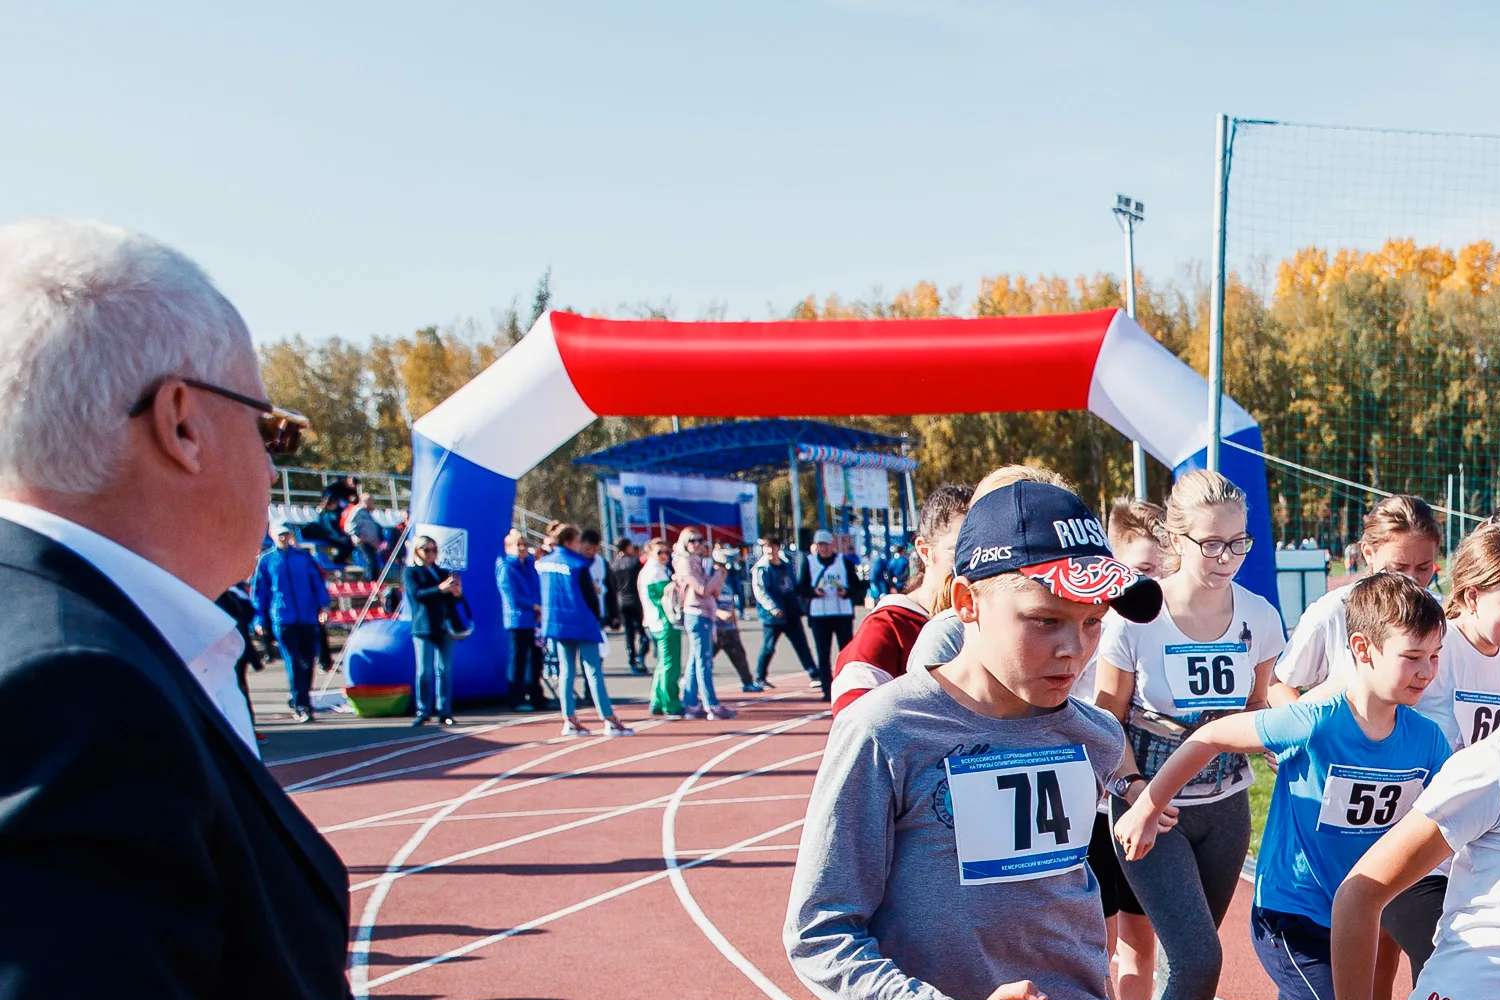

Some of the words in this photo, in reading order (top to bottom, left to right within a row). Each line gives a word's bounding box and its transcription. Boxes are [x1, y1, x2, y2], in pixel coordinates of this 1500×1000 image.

[1187, 655, 1235, 696] 56
[996, 770, 1071, 851] 74
[1346, 783, 1402, 826] 53
